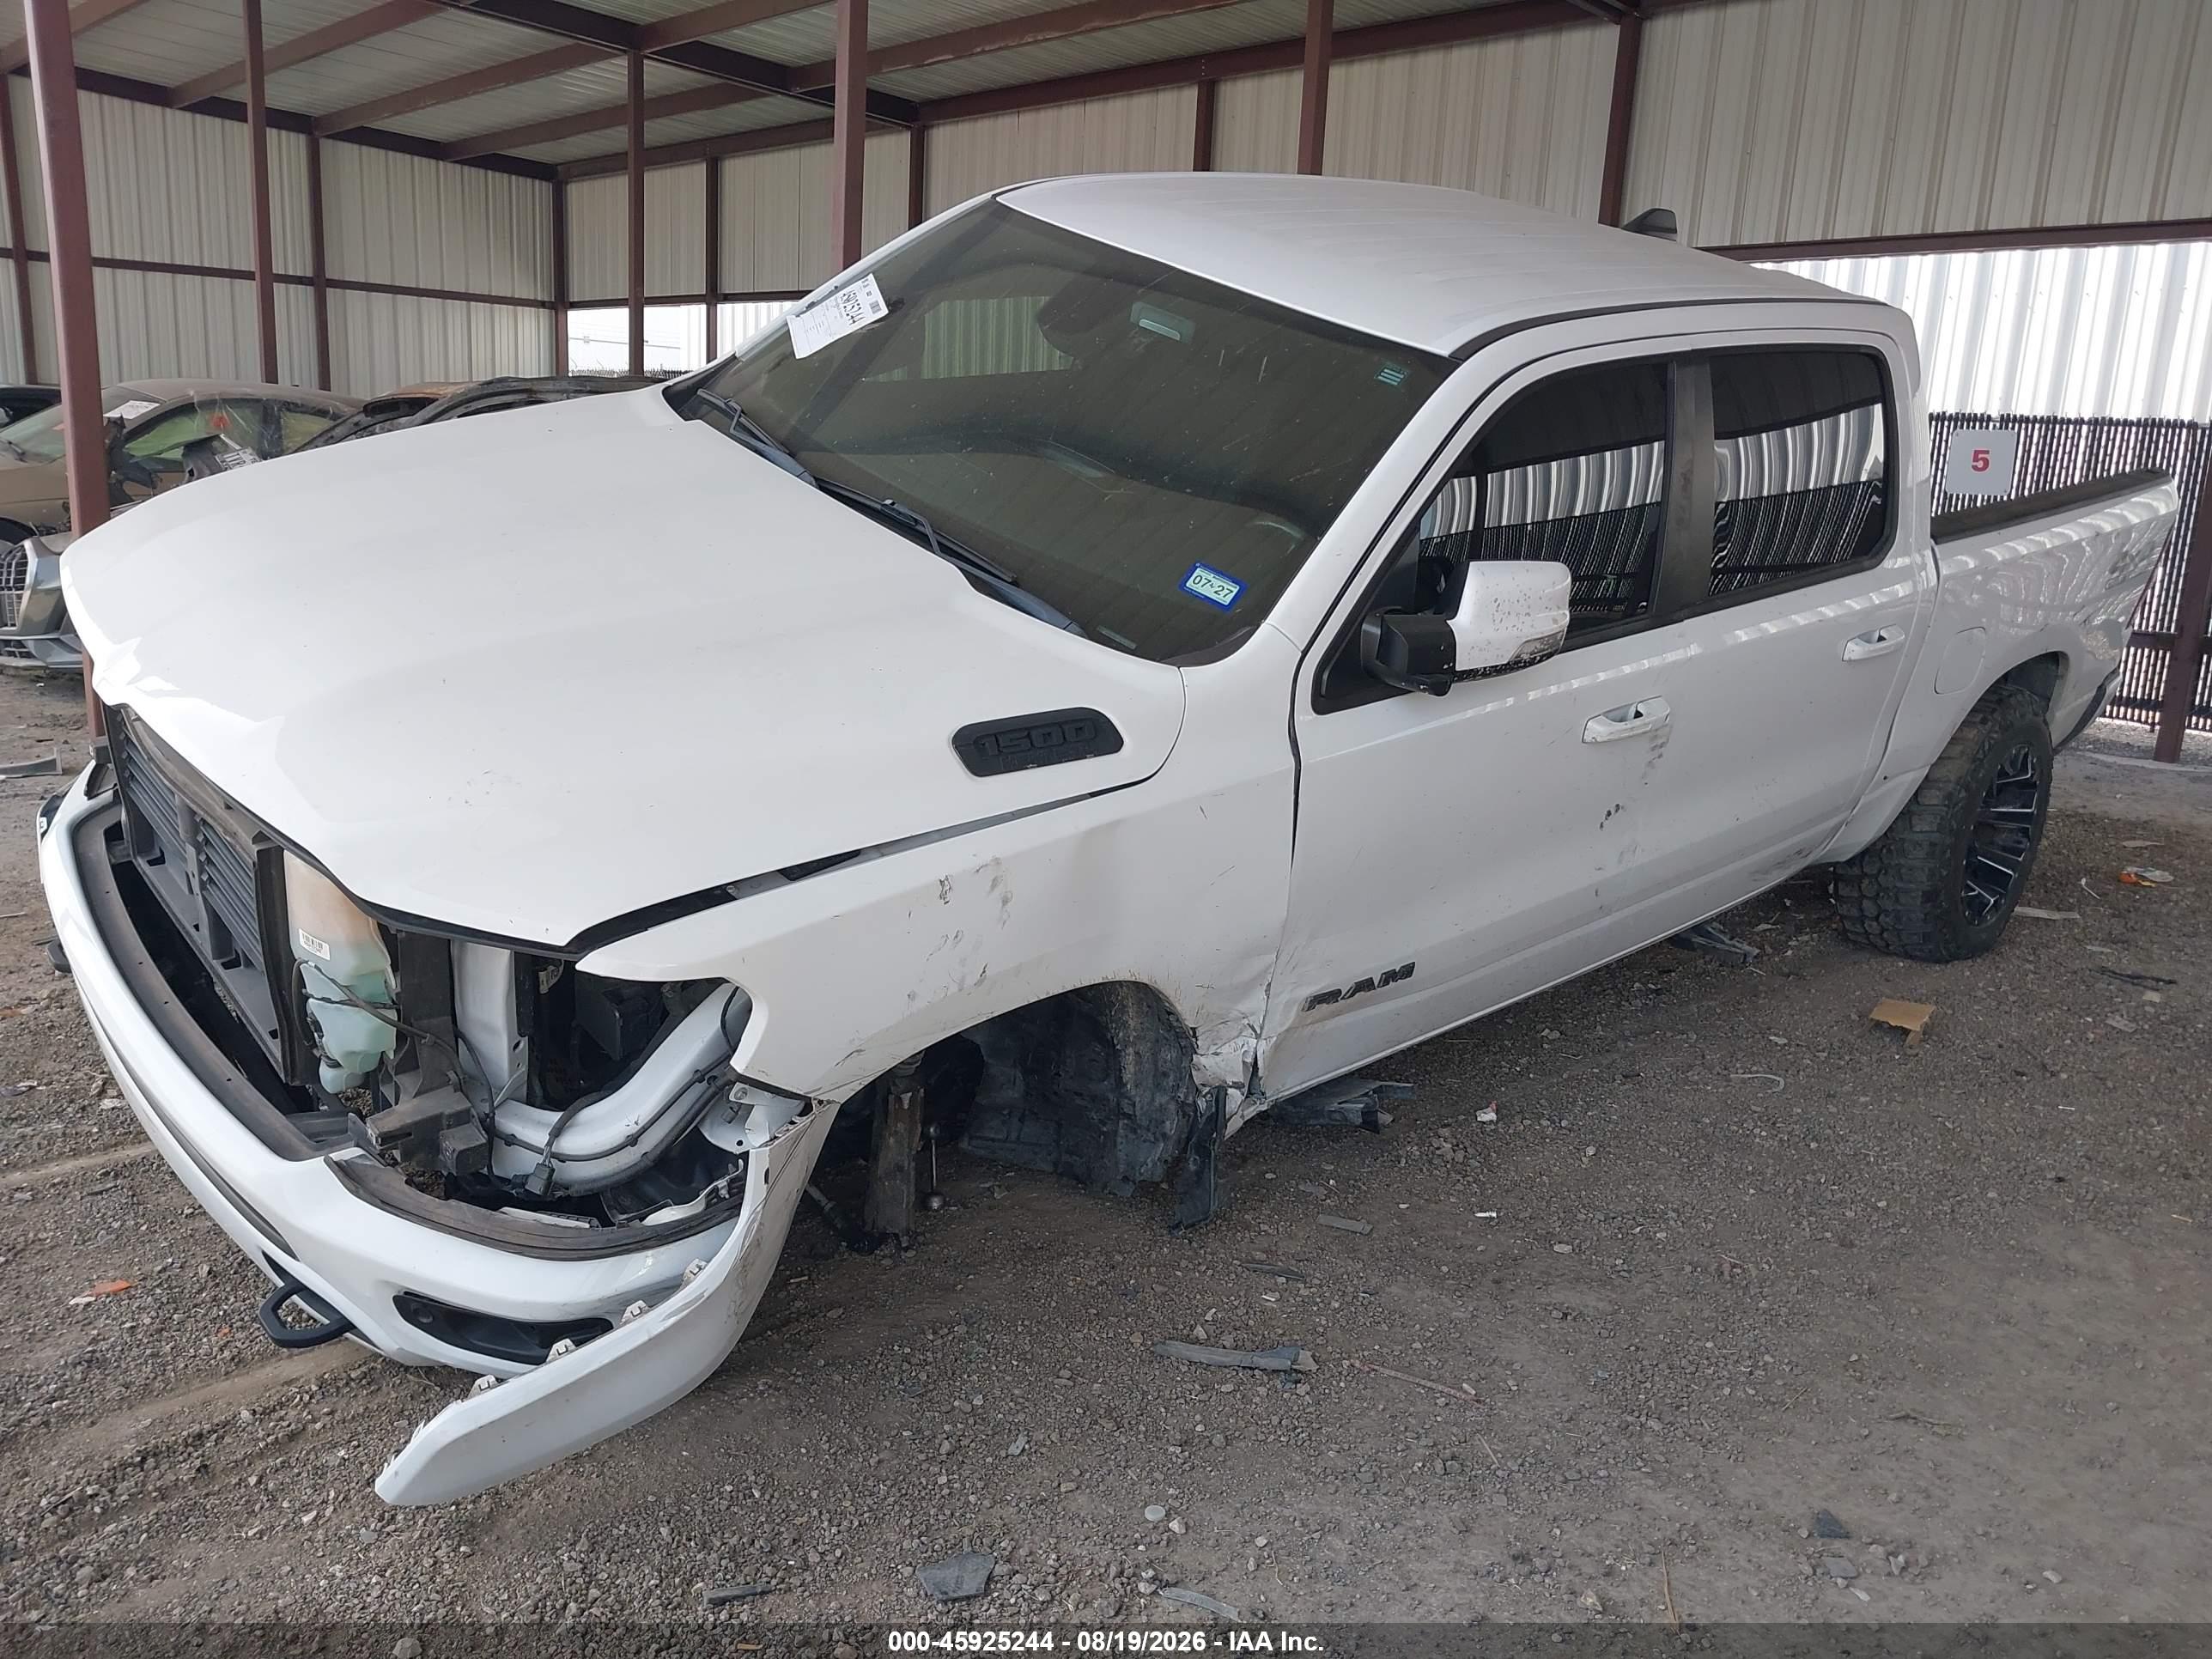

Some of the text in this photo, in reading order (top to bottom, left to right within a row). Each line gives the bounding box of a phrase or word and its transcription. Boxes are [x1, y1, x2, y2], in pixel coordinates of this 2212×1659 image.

[1971, 449, 1990, 472] 5
[973, 717, 1097, 757] 1500
[1301, 961, 1416, 1012] RAM
